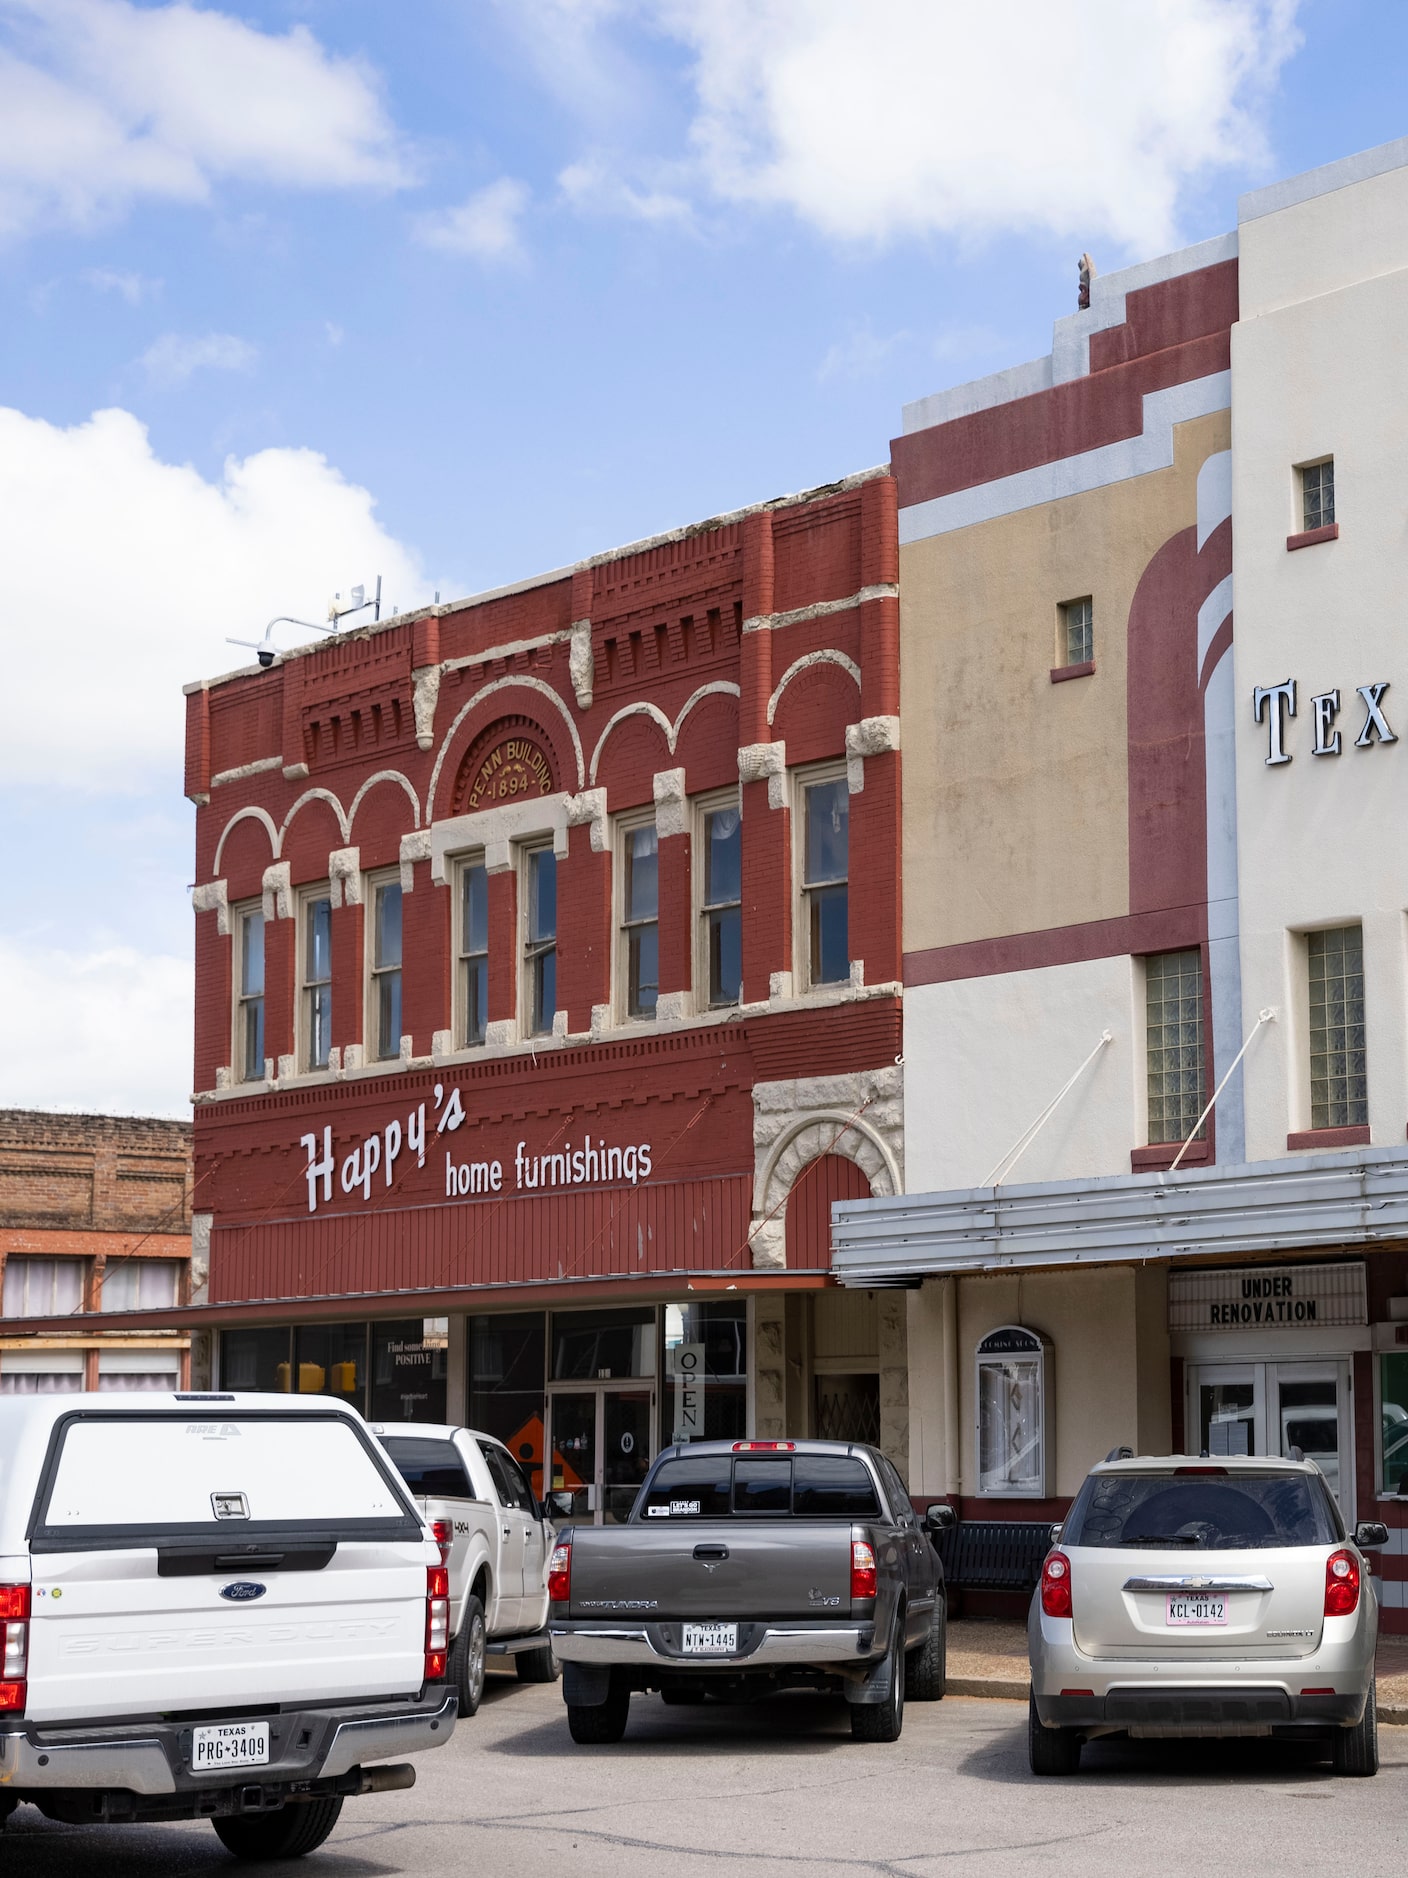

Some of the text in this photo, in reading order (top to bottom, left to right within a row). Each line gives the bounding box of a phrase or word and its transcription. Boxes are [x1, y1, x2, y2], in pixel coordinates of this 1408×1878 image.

[468, 740, 551, 809] PENN BUILDING
[300, 1083, 467, 1213] Happy's
[445, 1134, 653, 1197] home furnishings
[1241, 1276, 1293, 1299] UNDER
[1210, 1300, 1317, 1324] RENOVATION
[387, 1340, 441, 1353] Find something
[984, 1340, 1012, 1349] COMING
[395, 1352, 432, 1366] POSITIVE
[680, 1352, 698, 1428] OPEN
[230, 1584, 257, 1598] Ford
[602, 1600, 659, 1610] TUNDRA
[65, 1619, 398, 1655] SUPER DUTY
[1305, 1629, 1315, 1637] LT
[218, 1727, 246, 1737] TEXAS
